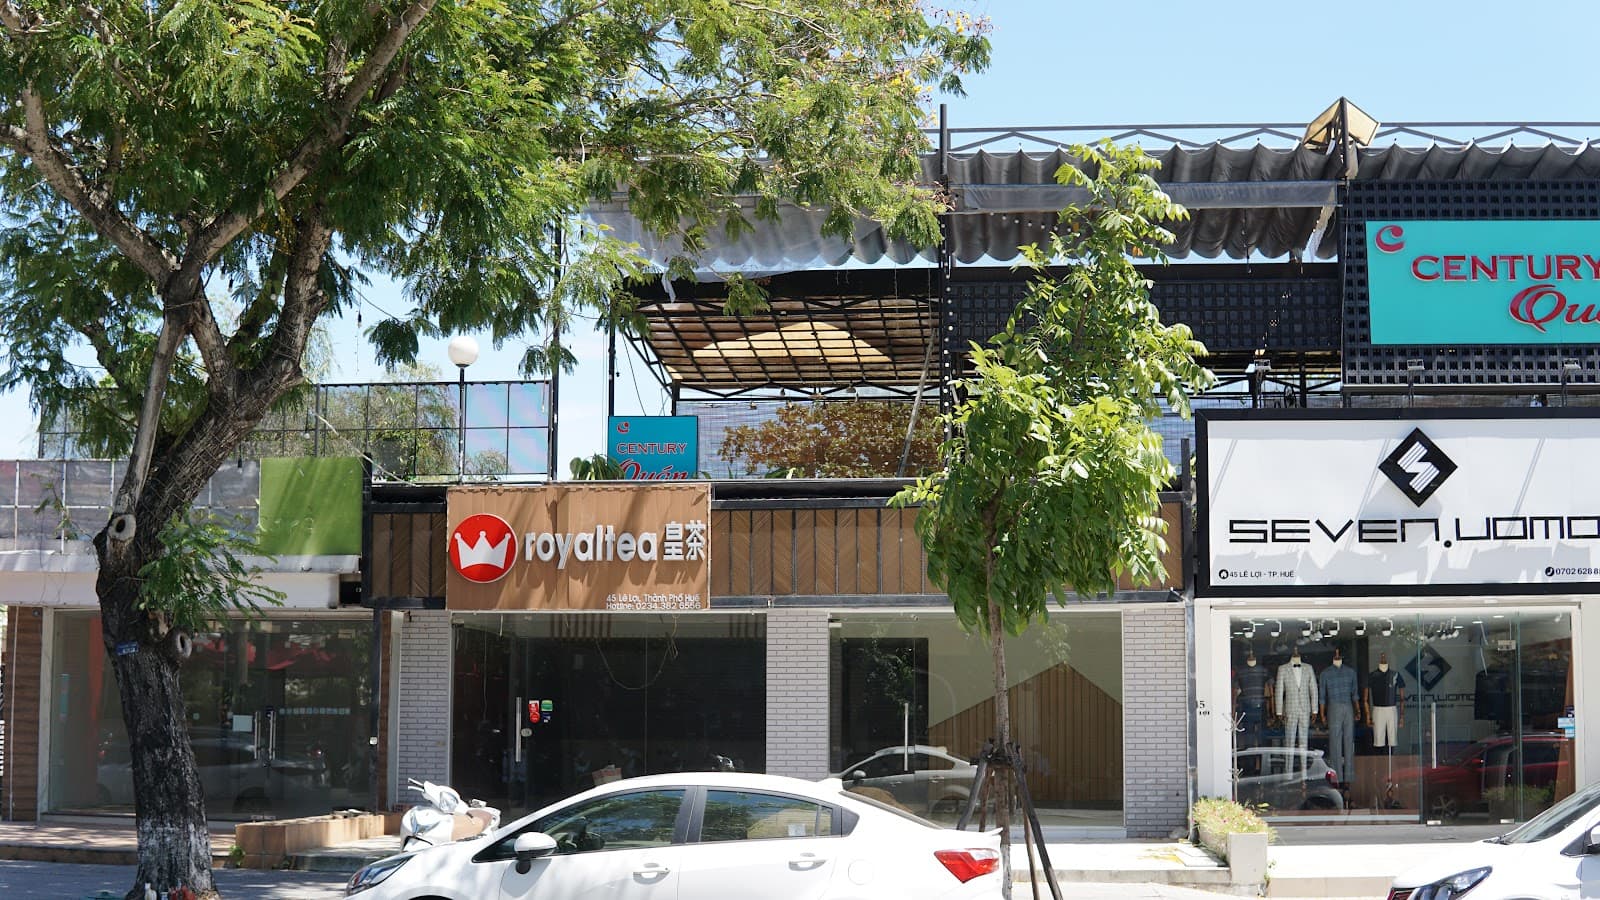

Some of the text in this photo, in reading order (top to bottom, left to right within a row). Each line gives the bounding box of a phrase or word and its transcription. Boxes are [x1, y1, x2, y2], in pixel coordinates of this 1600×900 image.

[1410, 254, 1600, 282] CENTURY
[1508, 283, 1600, 334] Qu
[617, 442, 688, 455] CENTURY
[525, 519, 706, 570] royaltea 皇茶
[1555, 567, 1576, 575] 0702
[1577, 567, 1592, 575] 628
[606, 593, 617, 602] 45
[606, 602, 634, 610] Hotline:
[636, 602, 658, 610] 0234
[660, 602, 677, 610] 382
